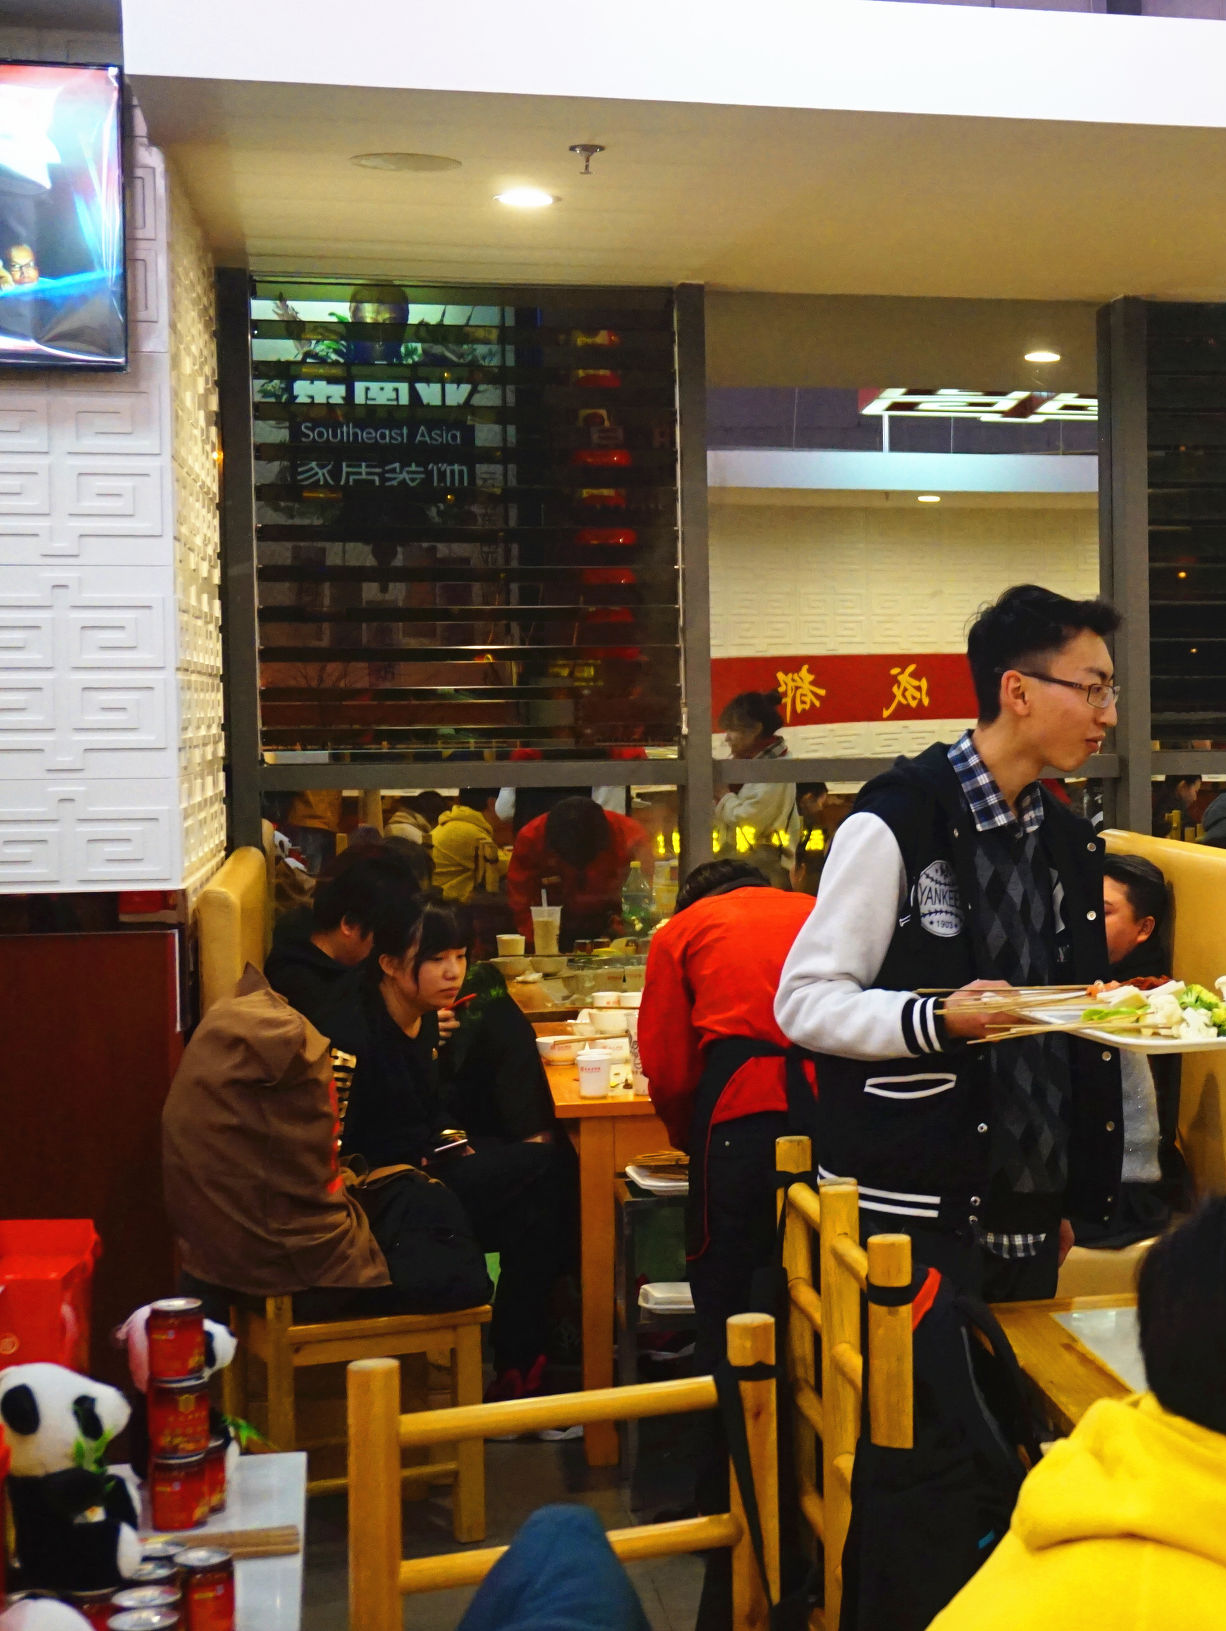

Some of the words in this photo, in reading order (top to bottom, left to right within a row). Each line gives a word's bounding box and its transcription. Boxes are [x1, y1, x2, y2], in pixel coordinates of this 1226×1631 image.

[300, 422, 408, 444] Southeast
[415, 424, 462, 446] Asia
[936, 919, 953, 930] 1903
